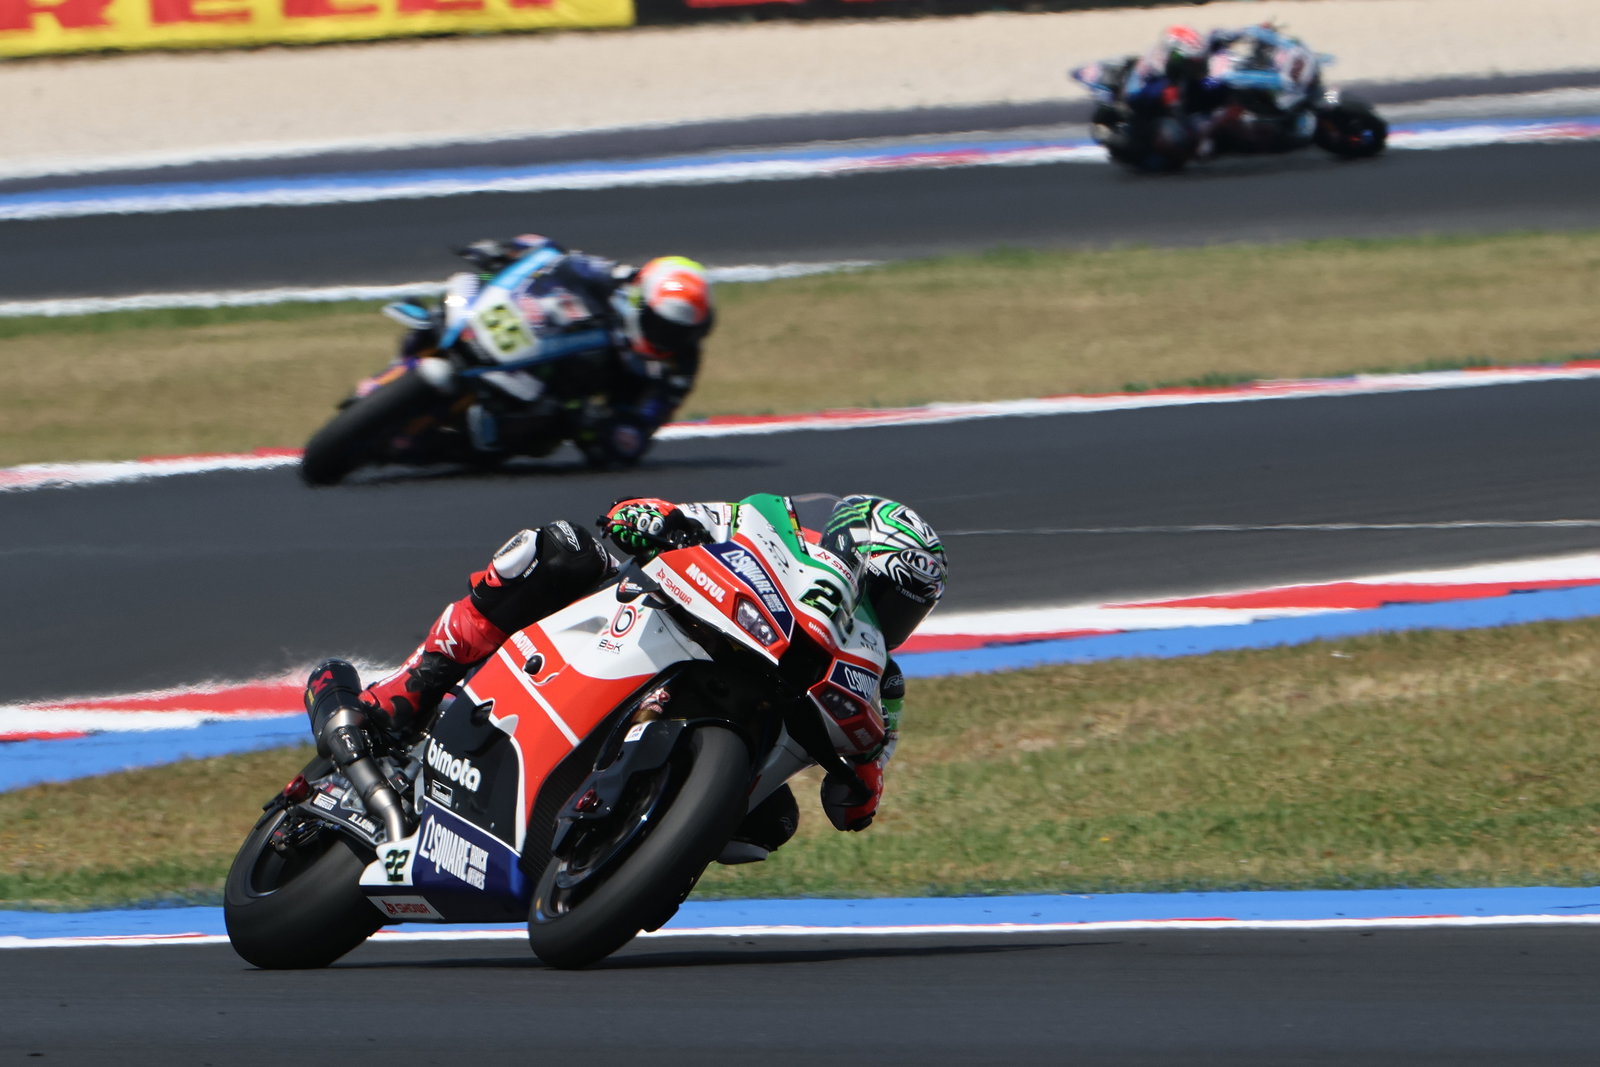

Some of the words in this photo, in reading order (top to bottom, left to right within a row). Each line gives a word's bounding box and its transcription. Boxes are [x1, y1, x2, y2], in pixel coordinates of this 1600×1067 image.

[664, 578, 693, 605] SHOWA
[685, 563, 727, 603] MOTUL
[385, 850, 410, 882] 22
[430, 823, 472, 882] SQUARE
